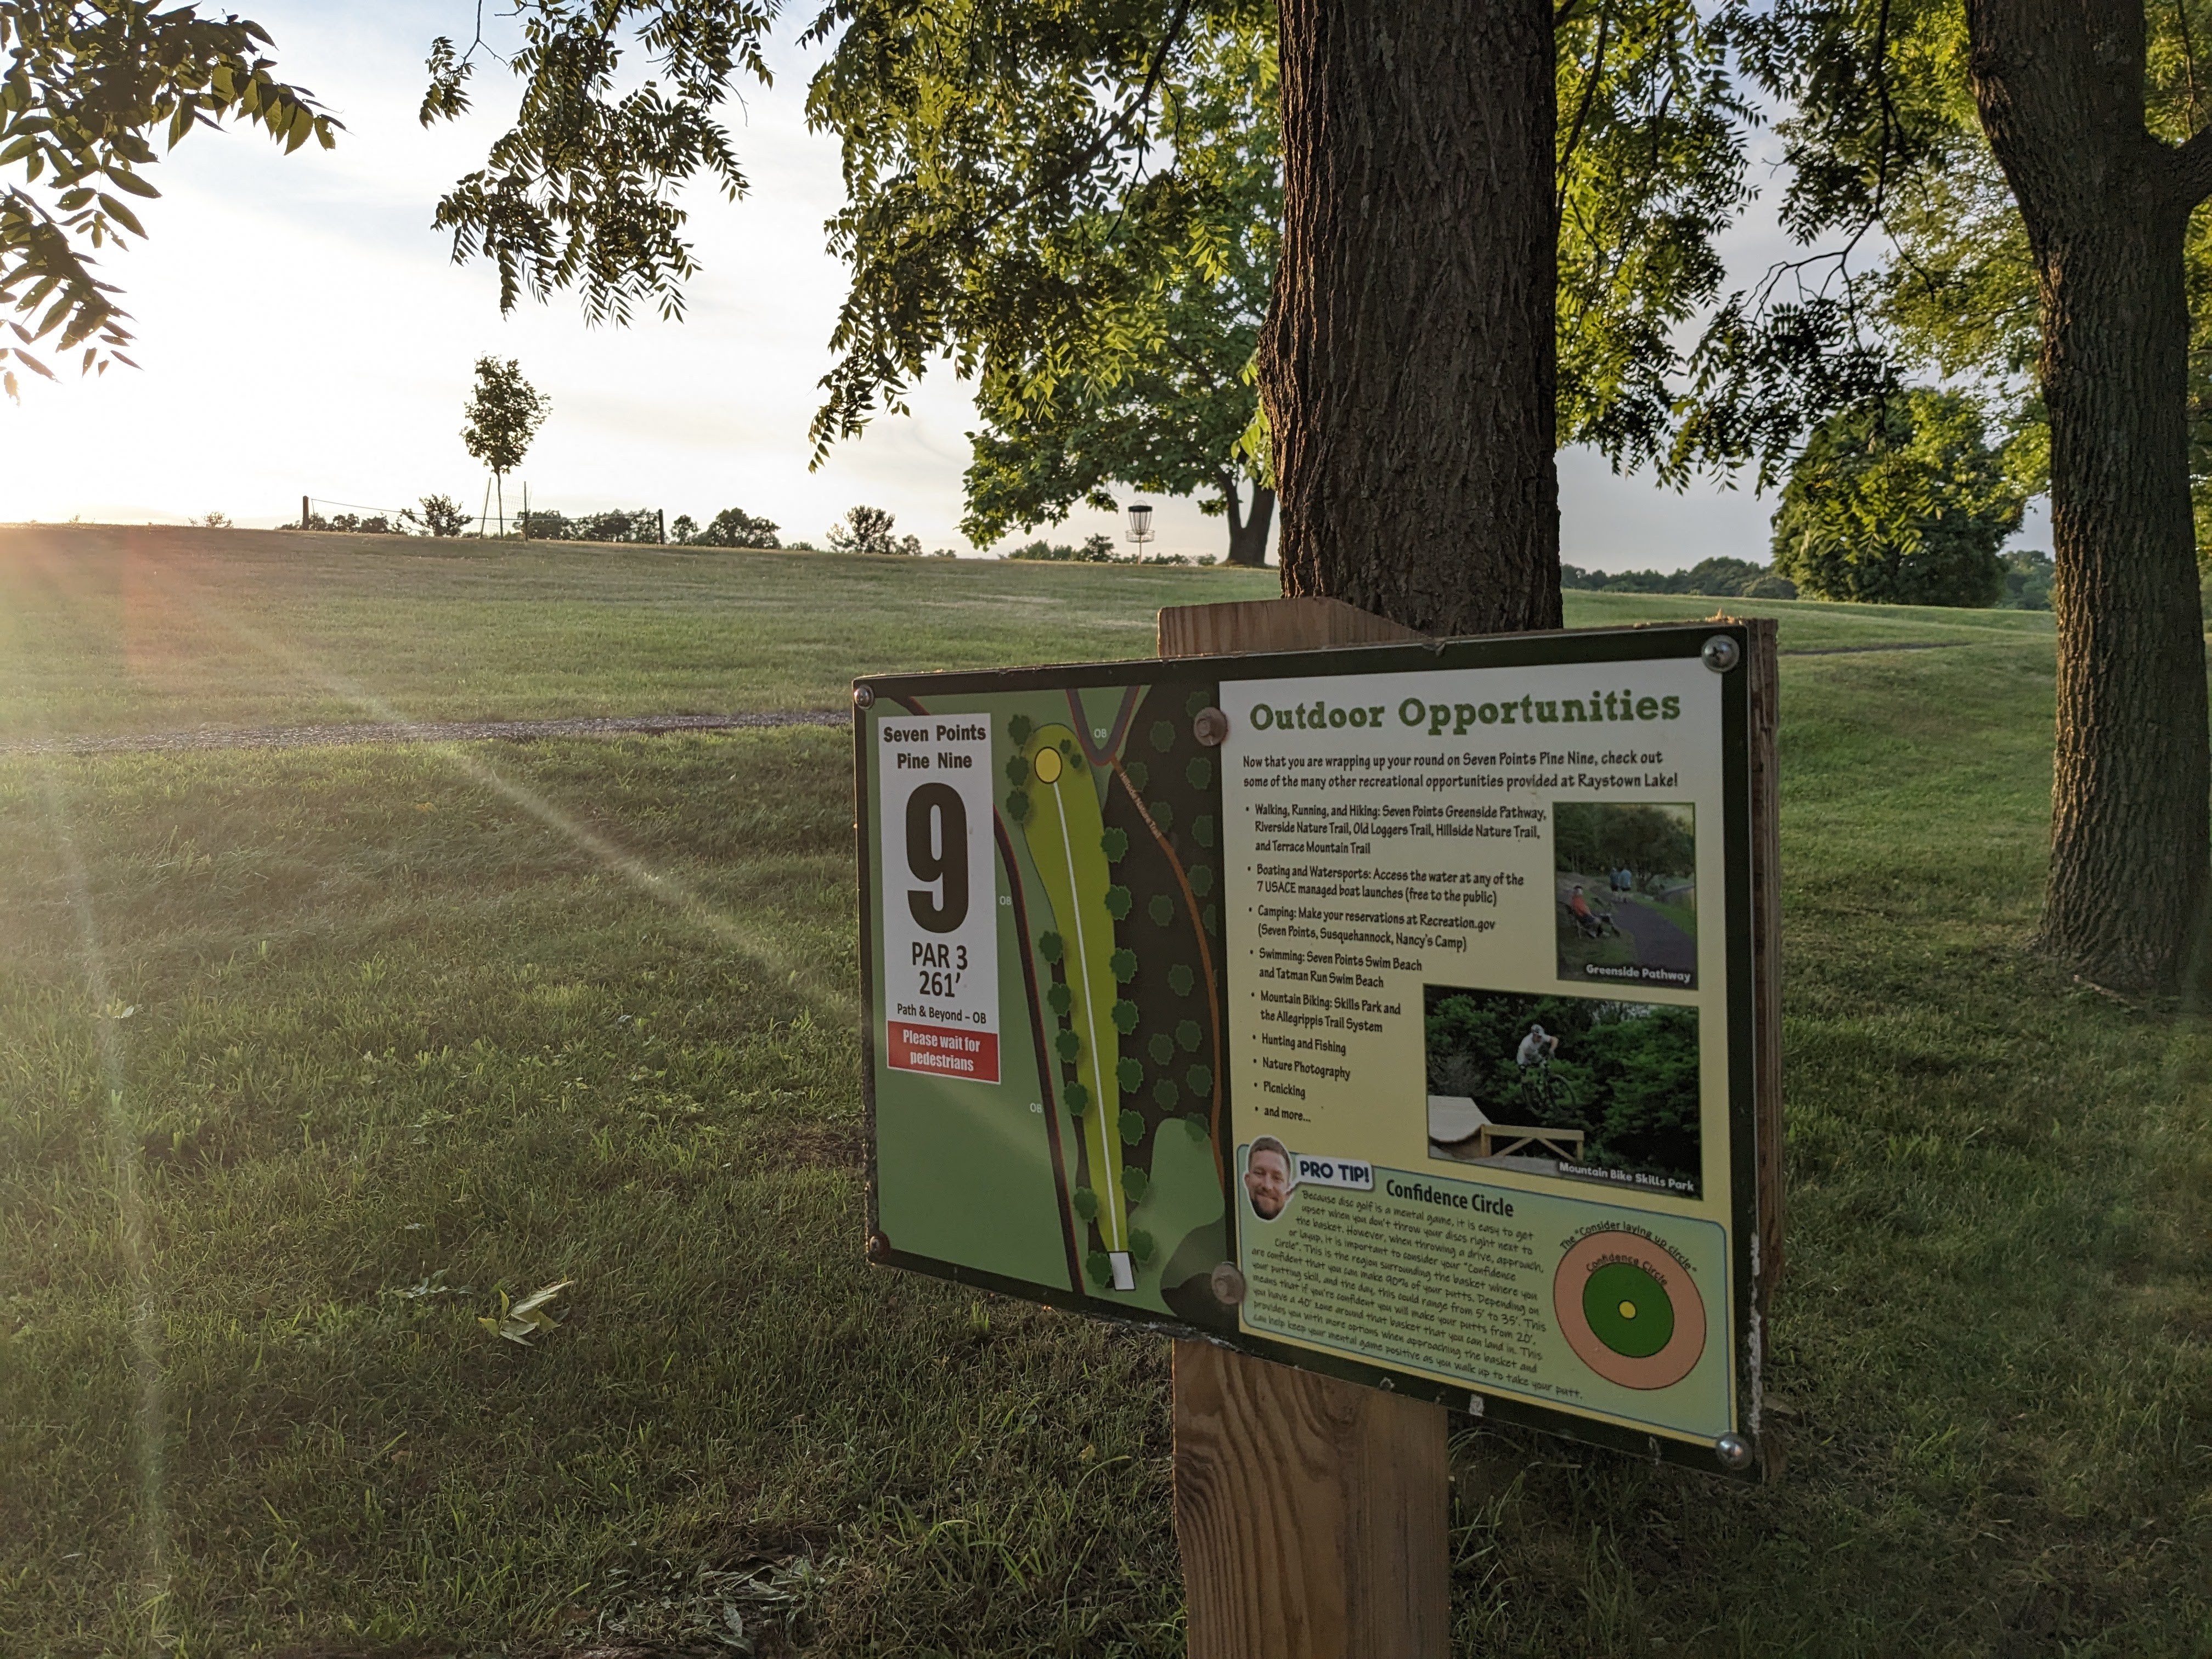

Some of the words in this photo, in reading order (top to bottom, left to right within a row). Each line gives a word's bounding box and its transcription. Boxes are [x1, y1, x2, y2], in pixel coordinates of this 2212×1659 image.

[1250, 701, 1385, 730] Outdoor
[1398, 689, 1680, 736] Opportunities
[883, 726, 929, 742] Seven
[936, 724, 986, 741] Points
[1094, 728, 1108, 738] OB
[897, 753, 930, 769] Pine
[938, 752, 972, 769] Nine
[1243, 755, 1262, 767] Now
[1265, 755, 1286, 768] that
[1288, 758, 1305, 770] you
[1307, 757, 1323, 767] are
[1325, 754, 1370, 771] wrapping
[1373, 758, 1385, 771] up
[1387, 757, 1411, 769] your
[1414, 753, 1444, 766] round
[1447, 756, 1460, 765] on
[1463, 752, 1496, 765] Seven
[1499, 752, 1536, 765] Points
[1539, 751, 1564, 764] Pine
[1567, 751, 1598, 766] Nine,
[1601, 749, 1637, 764] check
[1640, 751, 1663, 764] out
[1244, 777, 1268, 787] some
[1270, 775, 1282, 787] of
[1282, 775, 1298, 787] the
[1300, 777, 1326, 790] many
[1328, 774, 1356, 787] other
[1359, 774, 1423, 787] recreational
[1426, 774, 1503, 792] opportunities
[1506, 774, 1558, 791] provided
[1561, 775, 1575, 787] at
[1578, 774, 1641, 790] Raystown
[1645, 772, 1678, 787] Lake!
[1255, 804, 1289, 818] Walking,
[1291, 804, 1329, 819] Running,
[1330, 804, 1347, 816] and
[1349, 805, 1380, 820] Hiking:
[1382, 805, 1410, 817] Seven
[1413, 805, 1443, 817] Points
[1445, 805, 1497, 818] Greenside
[1499, 806, 1547, 821] Pathway,
[1255, 821, 1295, 832] Riverside
[1296, 822, 1327, 834] Nature
[1329, 822, 1351, 836] Trail,
[1353, 822, 1369, 834] Old
[1370, 823, 1408, 838] Loggers
[1409, 823, 1434, 837] Trail,
[1436, 824, 1473, 837] Hillside
[1475, 824, 1511, 837] Nature
[1513, 825, 1541, 839] Trail,
[906, 782, 969, 933] 9
[1255, 839, 1271, 851] and
[1272, 839, 1305, 852] Terrace
[1306, 841, 1348, 853] Mountain
[1350, 842, 1370, 854] Trail
[1257, 864, 1290, 878] Boating
[1291, 865, 1307, 876] and
[1309, 865, 1371, 882] Watersports:
[1373, 867, 1408, 881] Access
[1410, 869, 1426, 882] the
[1428, 871, 1458, 884] water
[1459, 872, 1471, 884] at
[1473, 874, 1491, 887] any
[1493, 872, 1505, 885] of
[1506, 872, 1524, 885] the
[1000, 895, 1012, 906] OB
[1257, 881, 1263, 891] 7
[1265, 881, 1296, 893] USACE
[1298, 884, 1337, 898] managed
[1339, 885, 1360, 897] boat
[1362, 885, 1403, 899] launches
[1405, 886, 1429, 903] (free
[1430, 889, 1442, 901] to
[1443, 889, 1461, 902] the
[1463, 890, 1497, 907] public)
[1258, 904, 1297, 921] Camping:
[1298, 907, 1322, 919] Make
[1323, 910, 1344, 922] your
[1345, 911, 1404, 924] reservations
[1407, 914, 1418, 926] at
[1420, 913, 1495, 933] Recreation.gov
[1258, 923, 1286, 938] (Seven
[1288, 925, 1318, 939] Points,
[1320, 927, 1394, 945] Susquehannock,
[1396, 932, 1433, 949] Nancy's
[1435, 934, 1466, 952] Camp)
[912, 941, 950, 969] PAR
[956, 945, 968, 970] 3
[1259, 947, 1305, 964] Swimming:
[1307, 951, 1333, 964] Seven
[1334, 953, 1363, 966] Points
[1365, 955, 1391, 968] Swim
[1393, 957, 1422, 970] Beach
[1259, 967, 1274, 978] and
[1276, 968, 1308, 981] Tatman
[1310, 970, 1327, 982] Run
[1329, 972, 1353, 985] Swim
[1356, 974, 1384, 988] Beach
[1586, 964, 1640, 977] Greenside
[1642, 968, 1691, 984] Pathway
[897, 1003, 917, 1016] Path
[919, 1006, 927, 1017] &
[929, 1007, 962, 1022] Beyond
[973, 1012, 986, 1024] OB
[1261, 990, 1301, 1005] Mountain
[1303, 995, 1333, 1010] Biking:
[1334, 997, 1359, 1011] Skills
[1362, 1000, 1382, 1013] Park
[1384, 1003, 1401, 1015] and
[1261, 1009, 1275, 1020] the
[1277, 1011, 1323, 1029] Allegrippis
[1325, 1016, 1344, 1029] Trail
[1346, 1018, 1383, 1032] System
[903, 1029, 938, 1047] Please
[939, 1035, 963, 1051] wait
[965, 1037, 980, 1052] for
[1262, 1032, 1295, 1050] Hunting
[1297, 1039, 1313, 1049] and
[1314, 1039, 1346, 1056] Fishing
[910, 1051, 974, 1071] pedestrians
[1262, 1057, 1292, 1071] Nature
[1294, 1060, 1350, 1081] Photography
[1263, 1081, 1305, 1099] Picnicking
[1030, 1102, 1042, 1113] OB
[1264, 1106, 1279, 1117] and
[1282, 1109, 1311, 1122] more...
[1300, 1160, 1333, 1179] PRO
[1338, 1164, 1370, 1183] TIP!
[1559, 1161, 1608, 1178] Mountain
[1610, 1169, 1632, 1181] Bike
[1635, 1173, 1666, 1187] Skills
[1668, 1178, 1694, 1192] Park
[1386, 1179, 1468, 1209] Confidence
[1471, 1194, 1515, 1217] Circle
[1302, 1189, 1336, 1205] Because
[1338, 1196, 1354, 1207] disc
[1356, 1200, 1373, 1212] golf
[1375, 1202, 1383, 1213] is
[1384, 1206, 1391, 1215] a
[1393, 1207, 1424, 1221] mental
[1426, 1214, 1454, 1227] game,
[1457, 1217, 1465, 1228] it
[1467, 1219, 1475, 1230] is
[1478, 1223, 1500, 1237] easy
[1502, 1227, 1513, 1236] to
[1515, 1230, 1534, 1242] get
[1559, 1235, 1576, 1250] The
[1623, 1221, 1652, 1241] laying
[1655, 1234, 1667, 1248] up
[1586, 1252, 1639, 1272] Confidence
[1643, 1260, 1668, 1286] Circle
